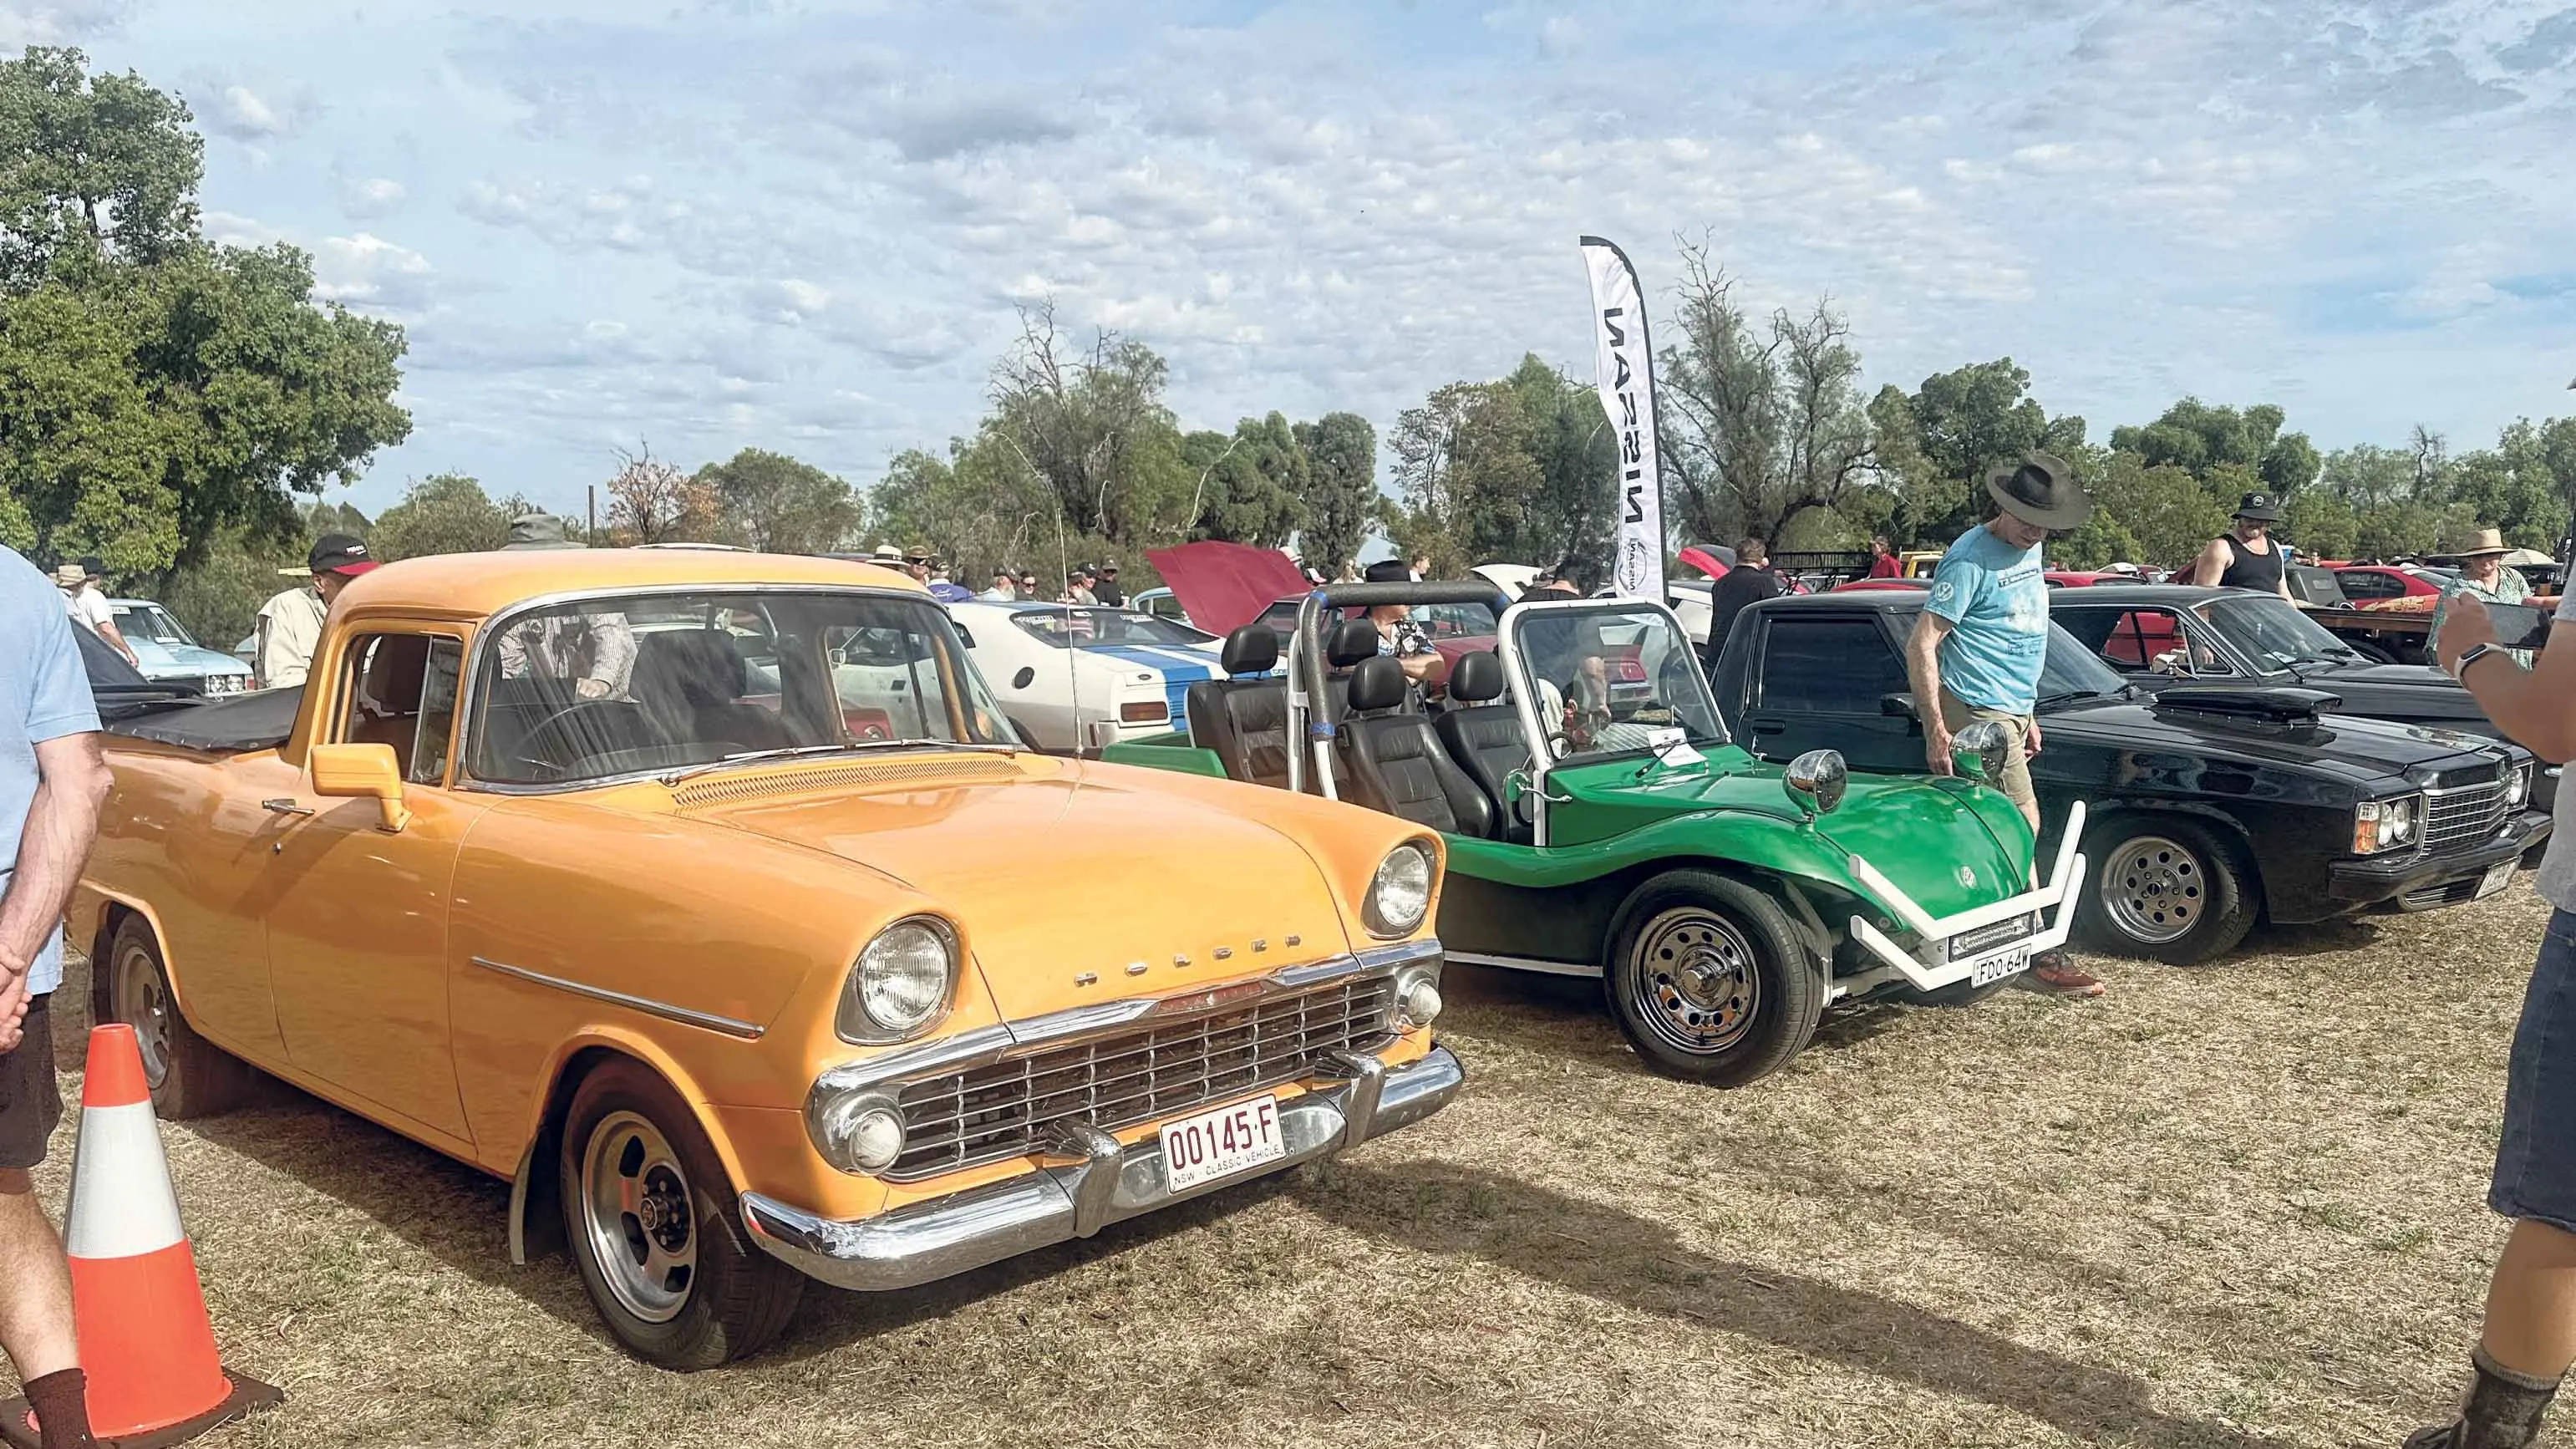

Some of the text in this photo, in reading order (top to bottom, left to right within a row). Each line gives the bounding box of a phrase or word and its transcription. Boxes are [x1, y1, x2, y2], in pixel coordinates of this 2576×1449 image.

[1174, 1144, 1281, 1185] NSW CLASSIC VEHICLE
